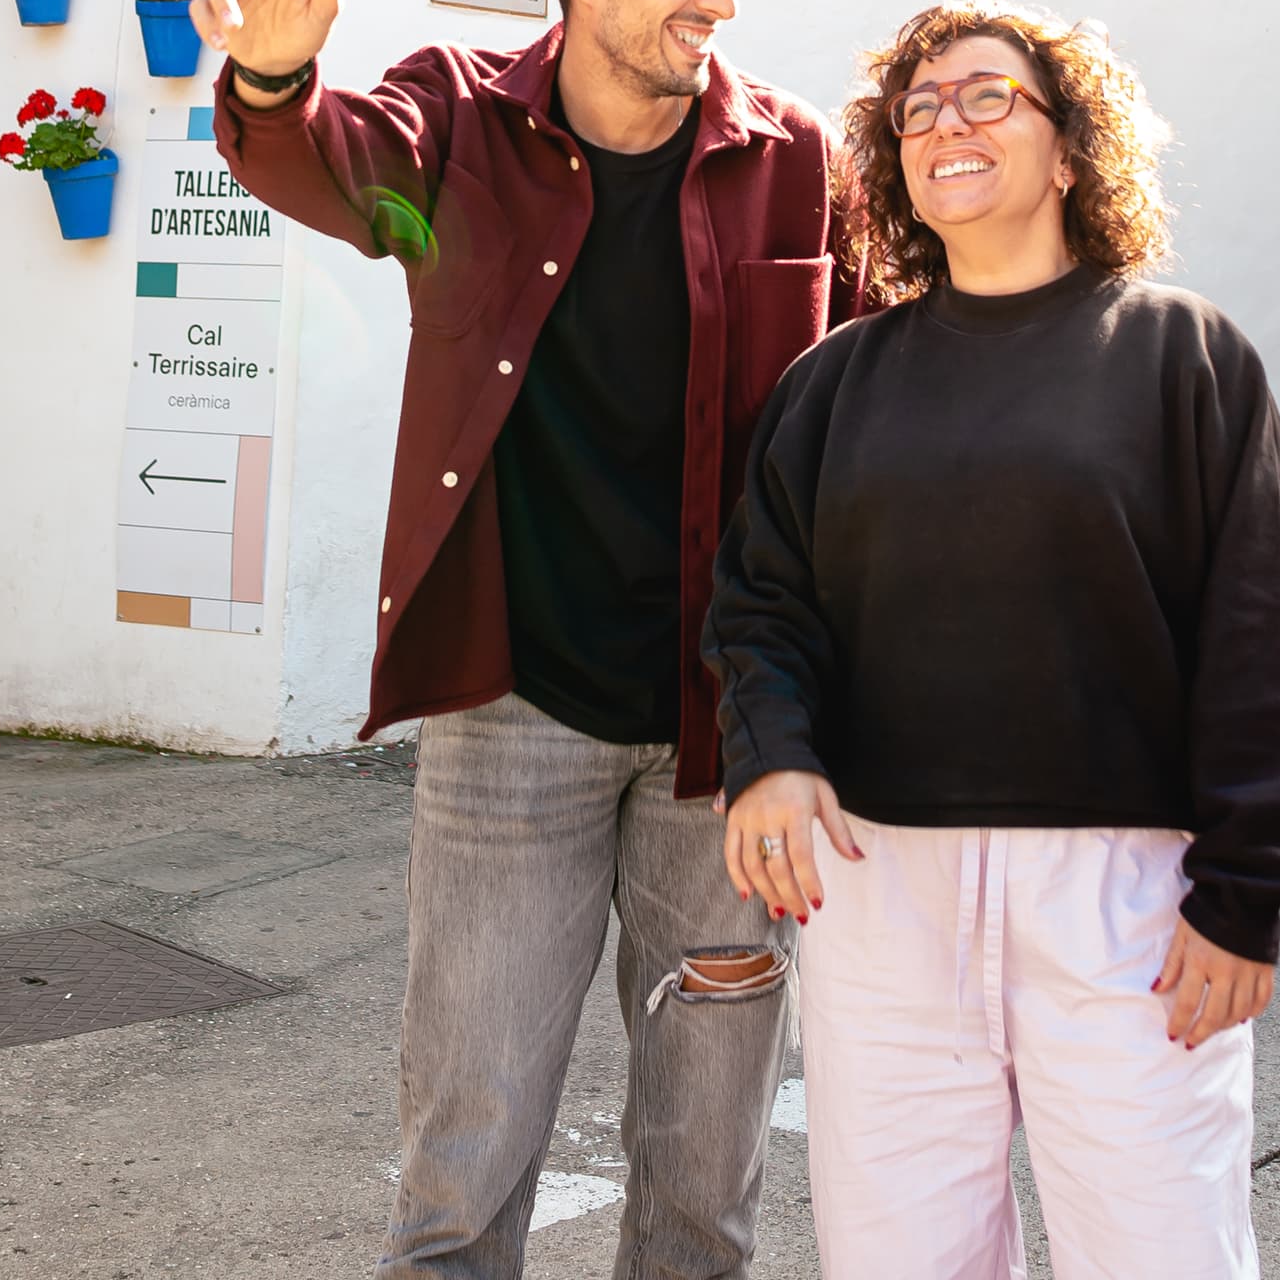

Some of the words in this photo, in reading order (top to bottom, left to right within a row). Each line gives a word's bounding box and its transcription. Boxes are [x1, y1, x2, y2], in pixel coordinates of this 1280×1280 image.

[174, 170, 251, 198] TALLER
[151, 208, 271, 237] D’ARTESANIA
[187, 323, 223, 346] Cal
[148, 352, 259, 379] Terrissaire
[167, 394, 231, 410] ceràmica
